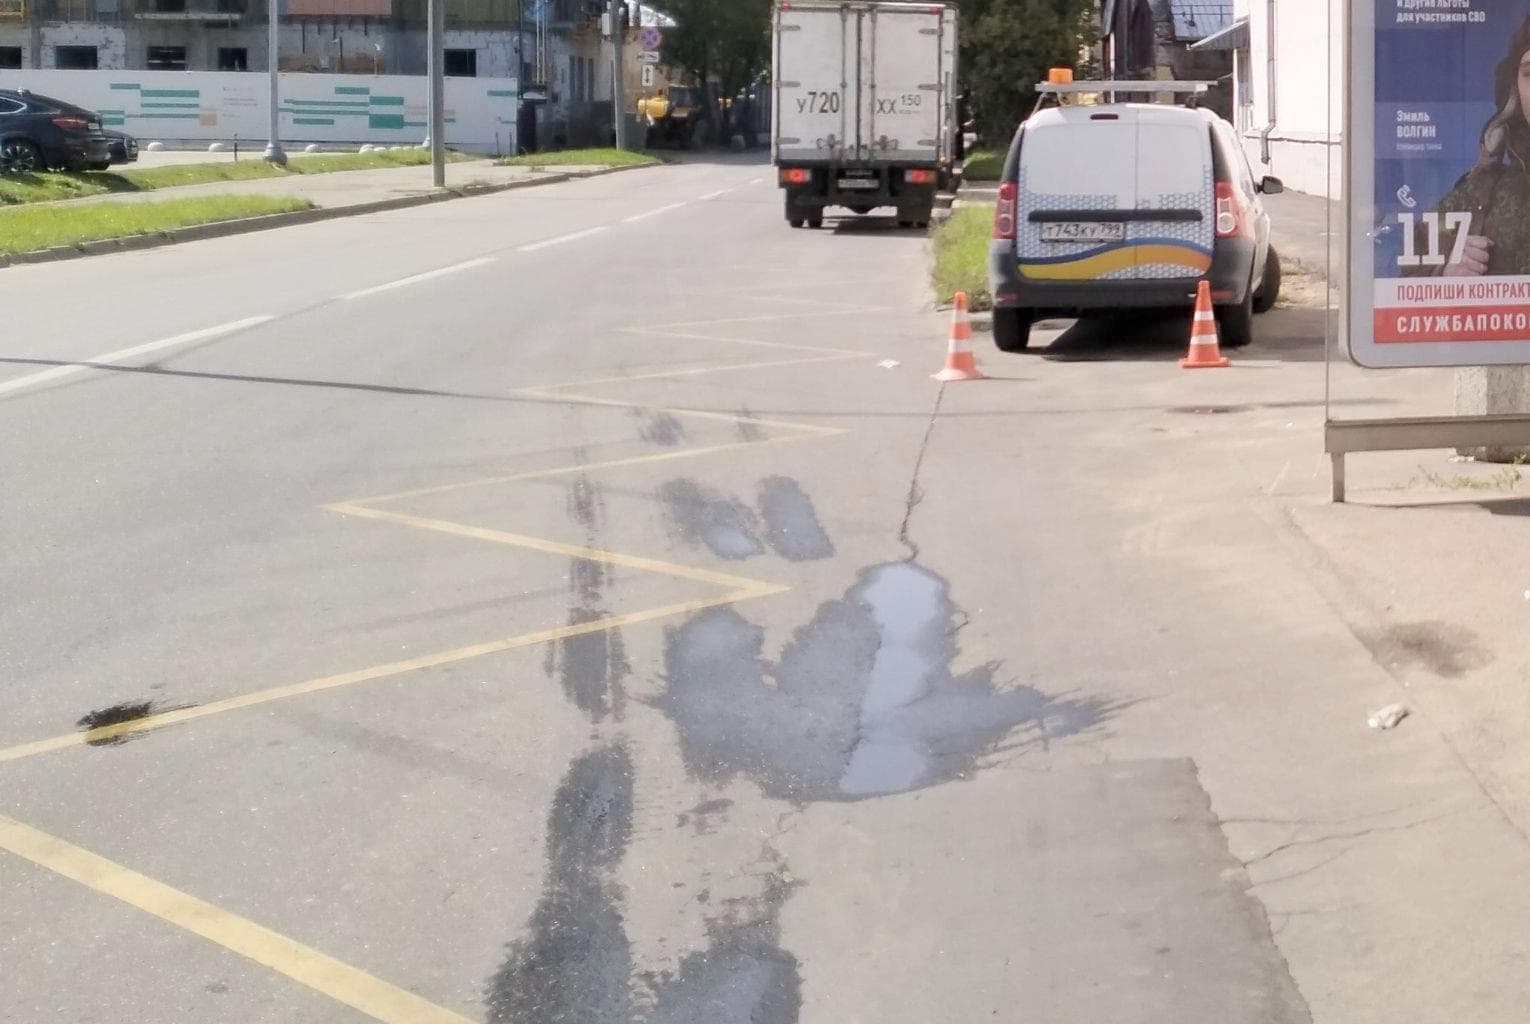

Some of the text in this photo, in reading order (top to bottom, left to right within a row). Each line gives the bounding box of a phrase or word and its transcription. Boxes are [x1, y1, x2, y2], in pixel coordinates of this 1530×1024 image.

[901, 94, 921, 106] 150
[1397, 212, 1472, 265] 117
[1396, 283, 1465, 303] ПОДПИШИ
